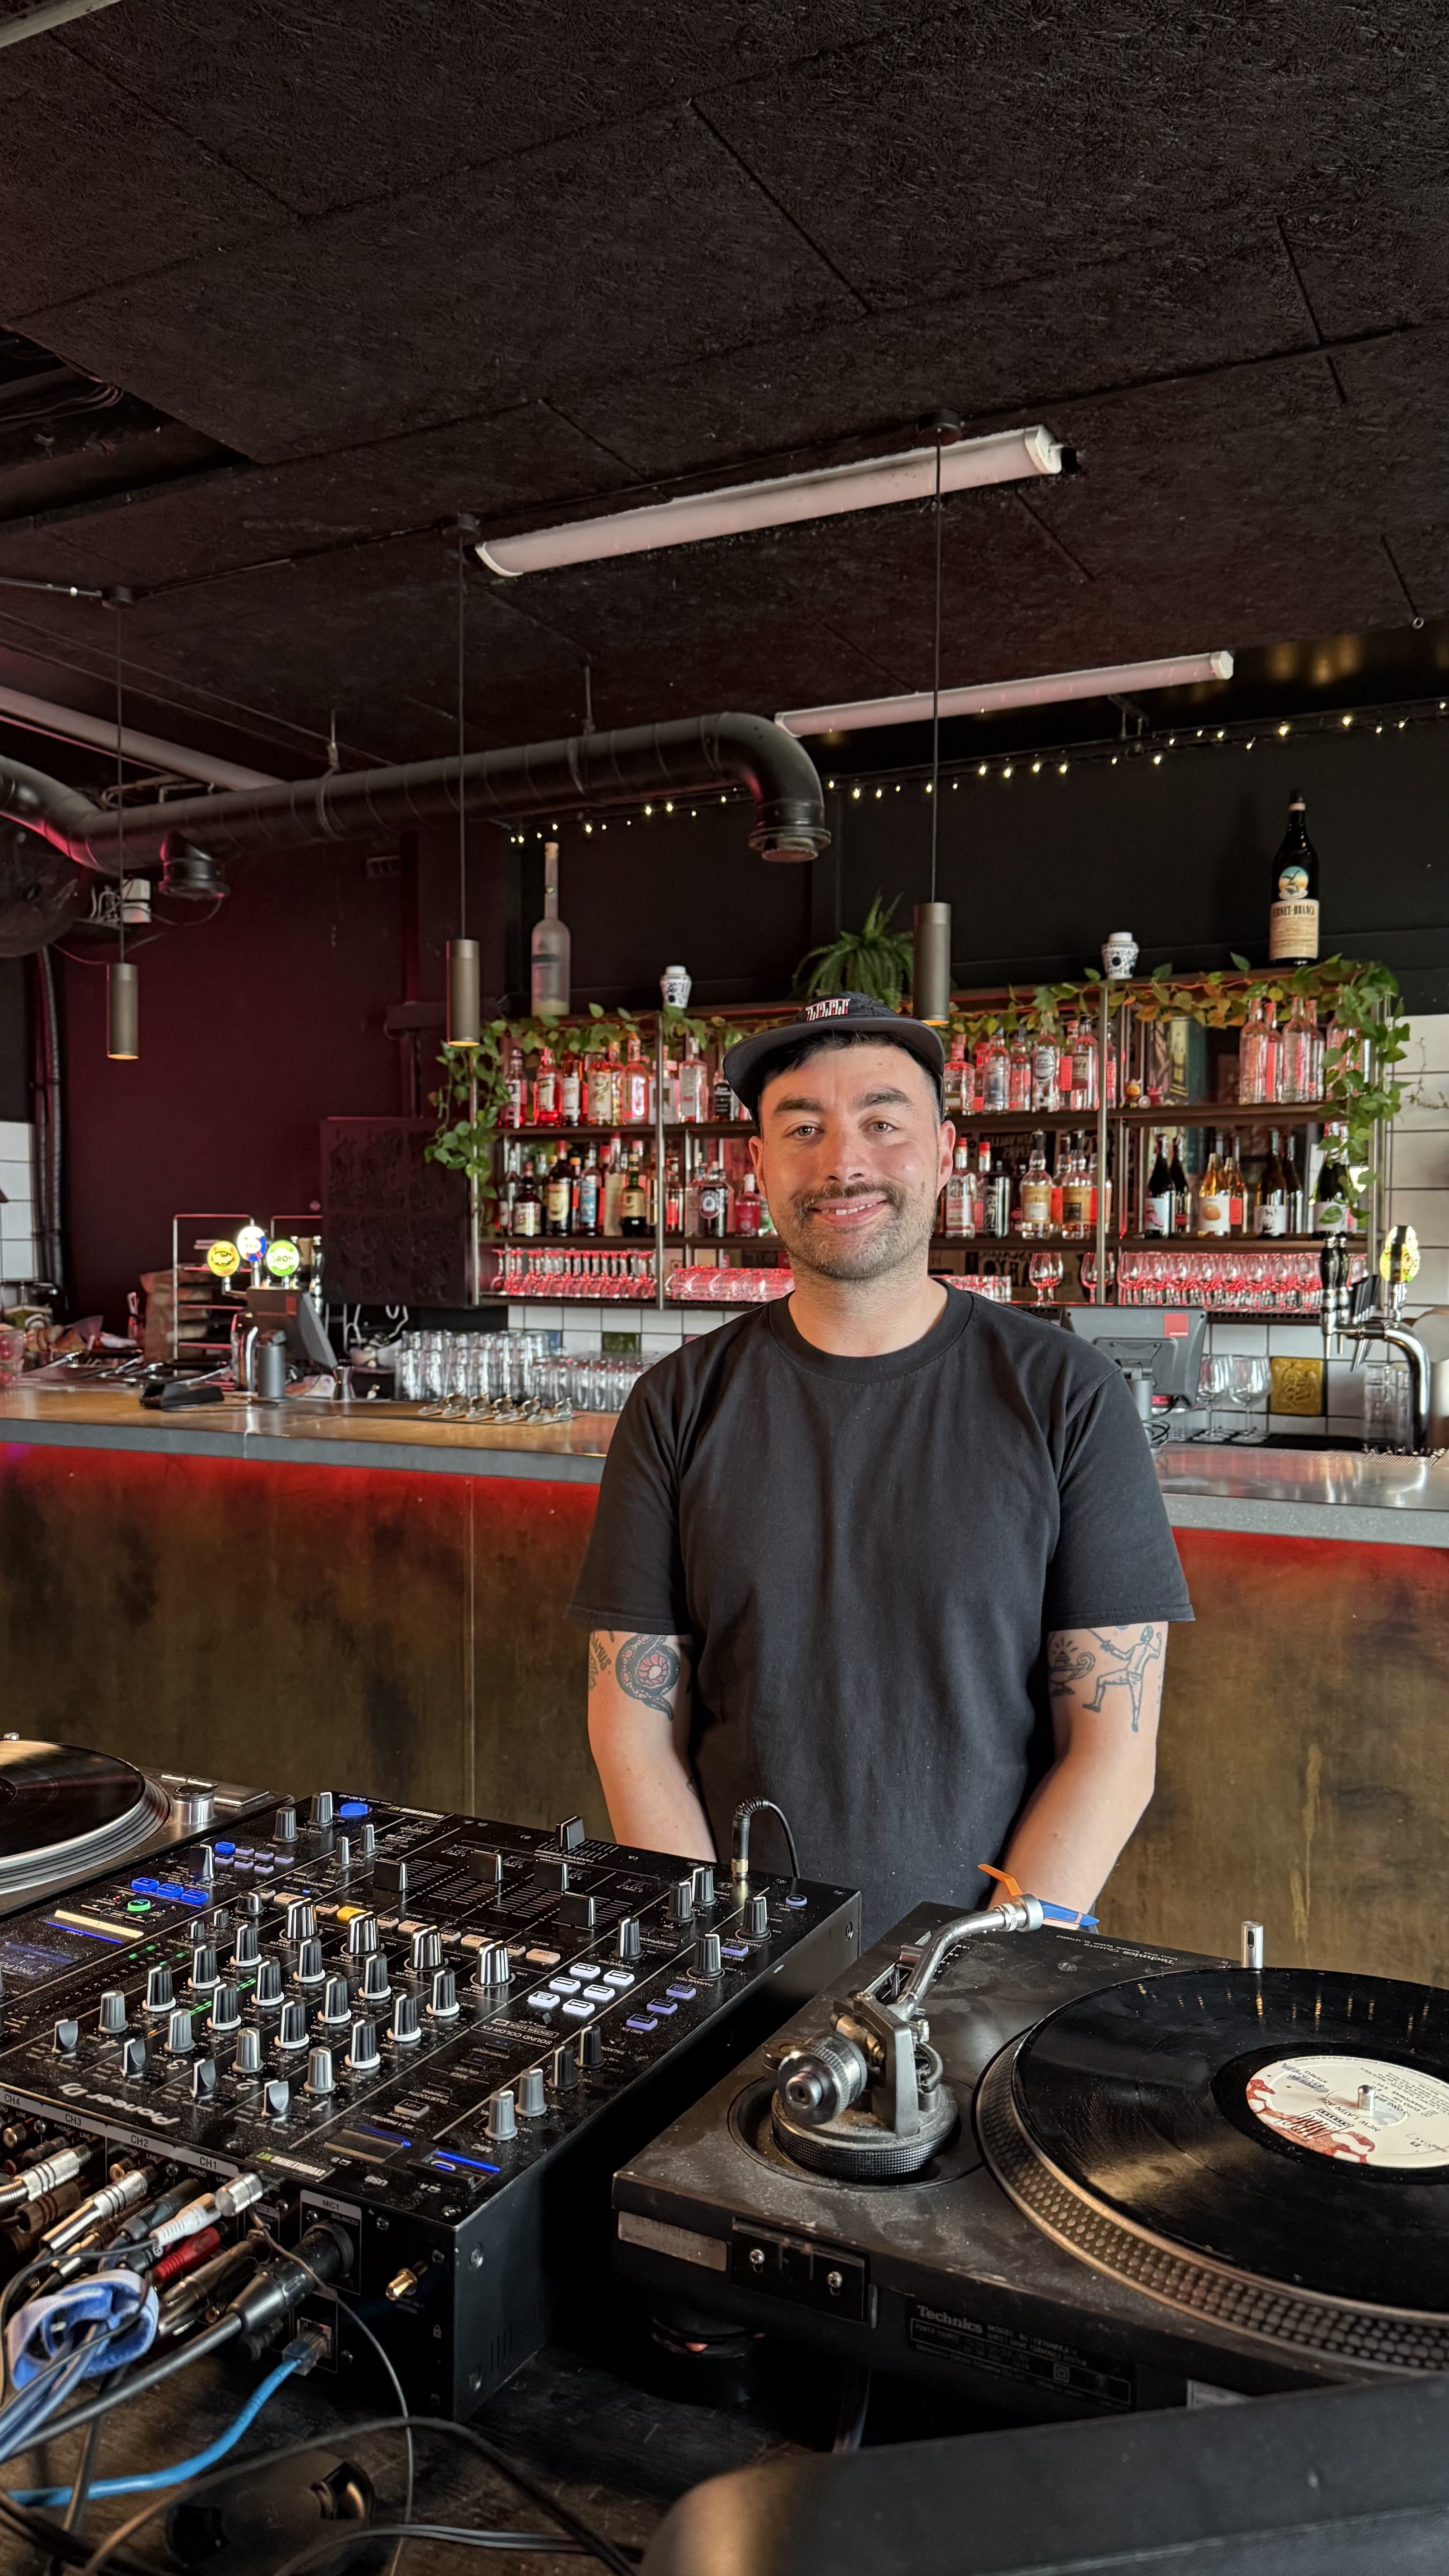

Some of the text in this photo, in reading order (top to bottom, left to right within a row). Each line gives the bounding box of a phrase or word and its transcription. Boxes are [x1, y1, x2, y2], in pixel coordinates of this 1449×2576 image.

[639, 1937, 678, 1948] HEADPHON
[493, 2027, 523, 2038] COLOR
[527, 2026, 554, 2037] CENTER
[98, 2039, 119, 2049] 4
[523, 2034, 553, 2045] SOUND
[166, 2058, 188, 2070] 3
[57, 2082, 89, 2098] DJ
[235, 2078, 260, 2091] 2
[5, 2093, 20, 2107] CH4
[407, 2090, 449, 2105] BLUETOOTH
[85, 2093, 181, 2126] Pioneer
[311, 2100, 329, 2112] 1
[1336, 2106, 1360, 2120] LATIN
[65, 2113, 82, 2126] CH3
[1359, 2120, 1380, 2132] NEW
[131, 2135, 149, 2148] CH2
[471, 2143, 493, 2153] MIC
[199, 2157, 217, 2170] CH1
[364, 2175, 388, 2187] USB
[916, 2304, 983, 2334] Technics
